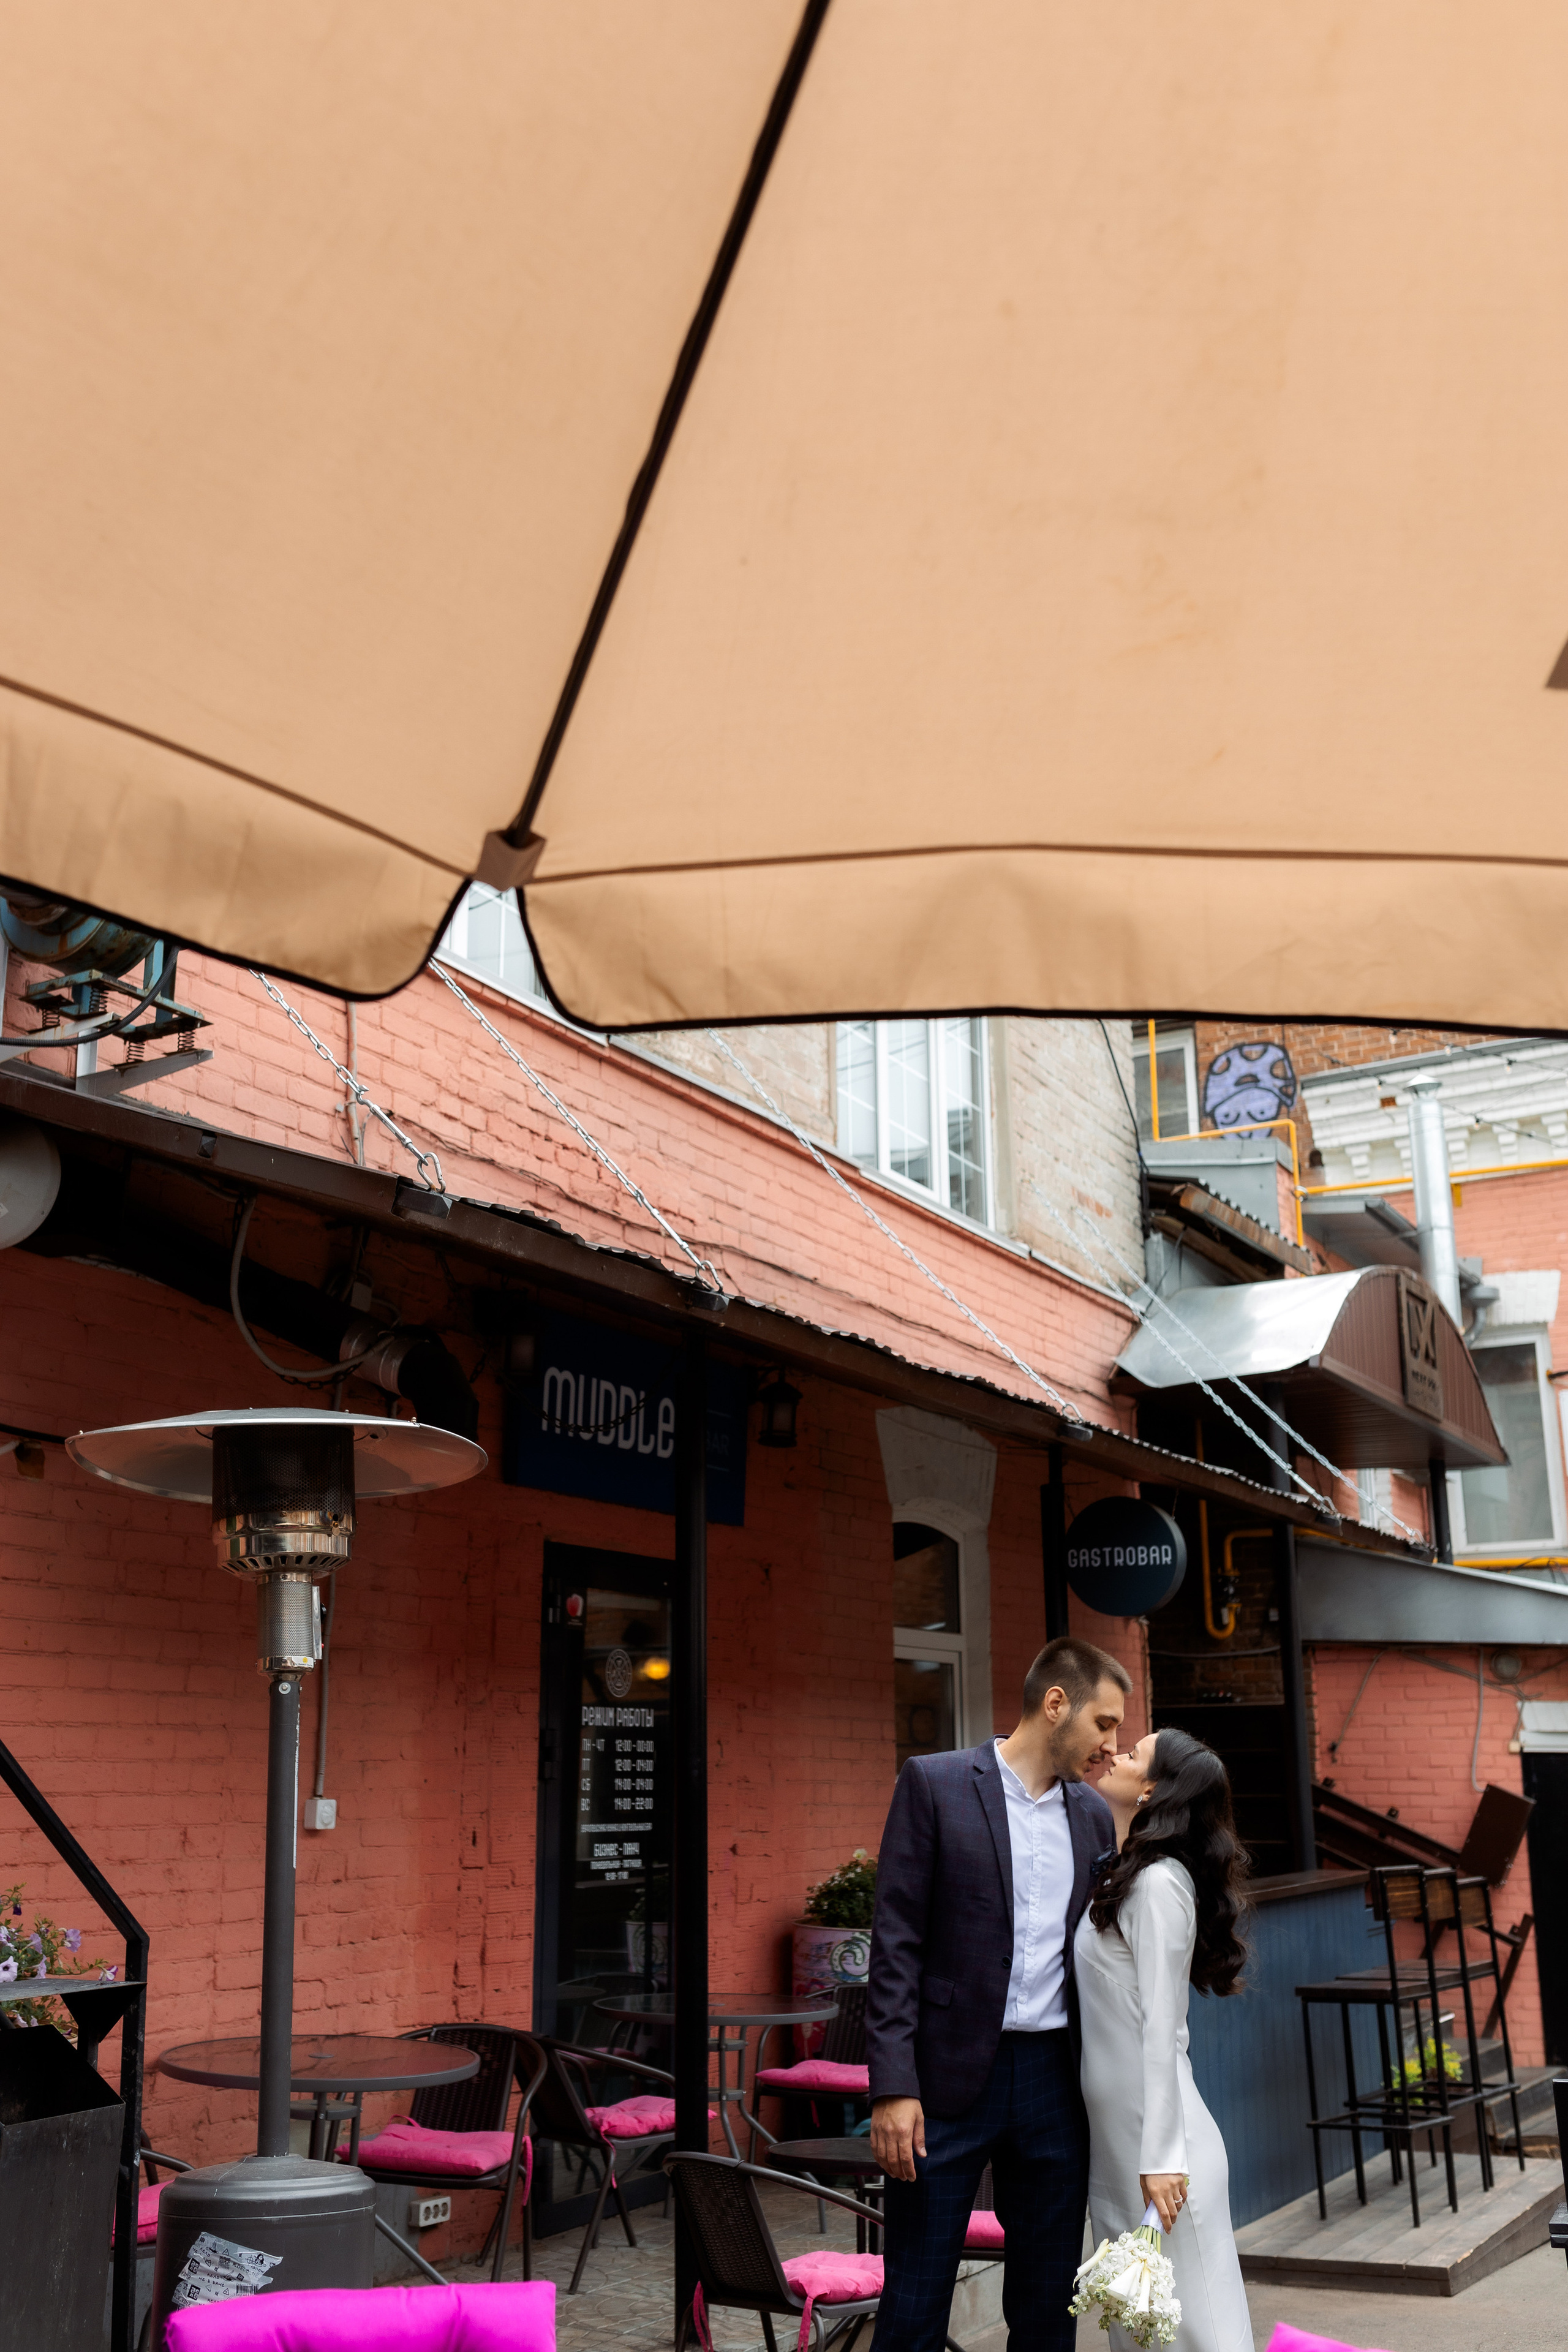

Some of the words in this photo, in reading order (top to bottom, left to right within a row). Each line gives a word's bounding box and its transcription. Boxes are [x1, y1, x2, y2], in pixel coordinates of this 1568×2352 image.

[1068, 1545, 1172, 1567] GASTROBAR
[616, 1707, 654, 1727] РАБОТЫ
[581, 1758, 591, 1771] ПТ
[581, 1778, 591, 1791] СБ
[581, 1798, 590, 1811] ВС
